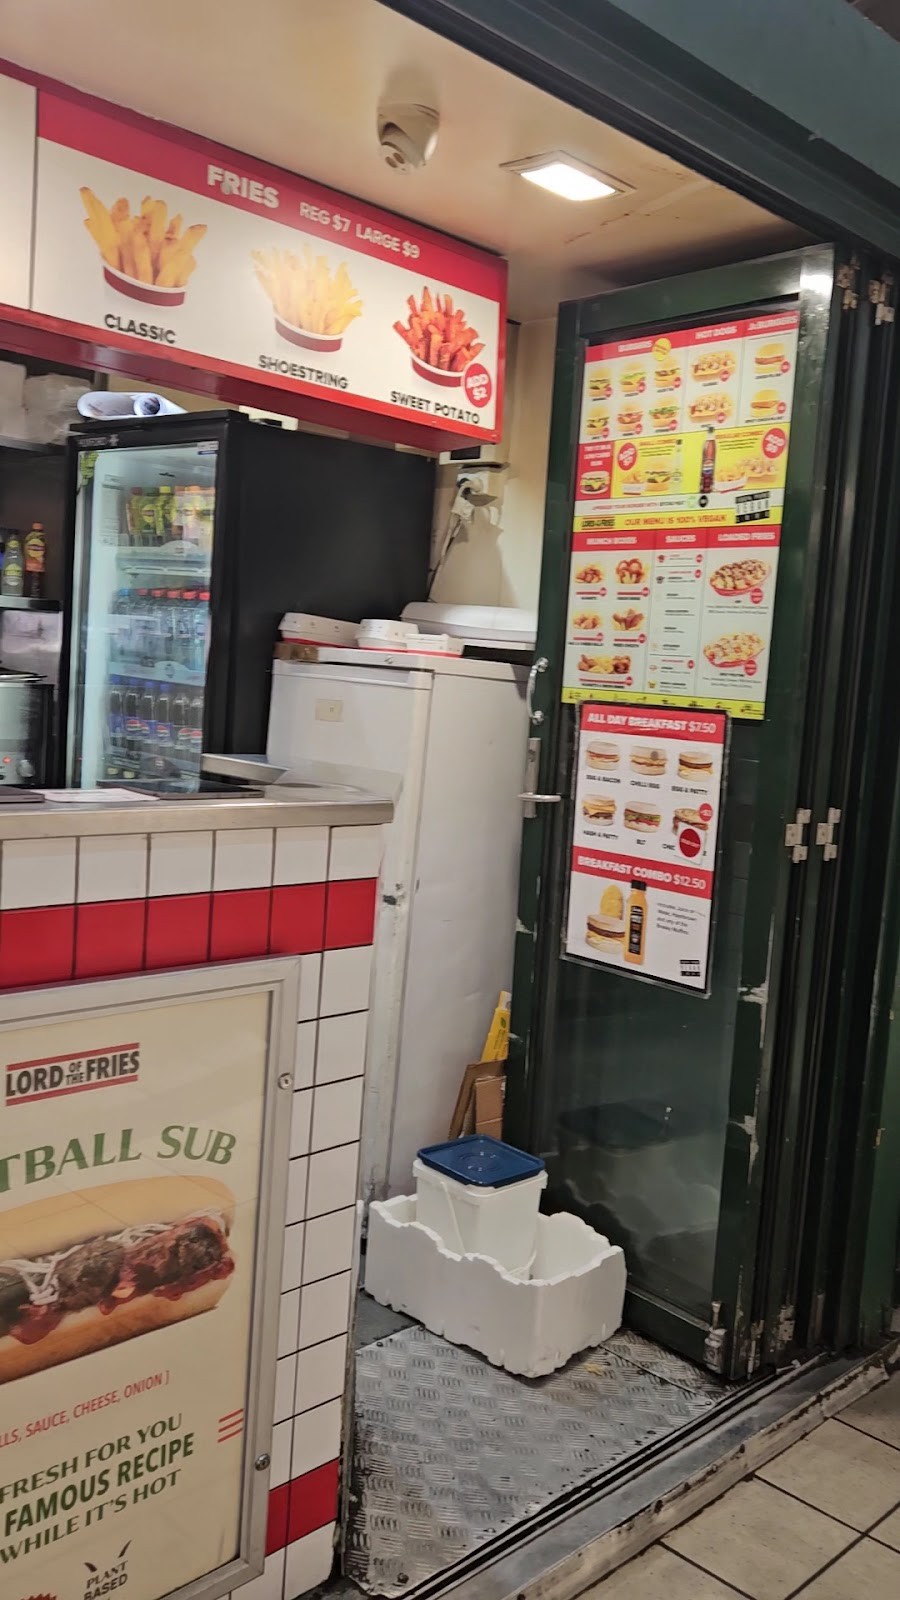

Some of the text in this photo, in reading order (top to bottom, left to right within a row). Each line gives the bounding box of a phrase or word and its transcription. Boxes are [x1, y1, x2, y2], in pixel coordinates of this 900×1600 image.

[206, 164, 280, 209] FRIES
[299, 202, 420, 259] REG $7 LARGE $9
[104, 314, 176, 344] CLASSIC
[258, 355, 349, 390] SHOESTRING
[390, 391, 480, 426] SWEET POTATO
[643, 517, 664, 525] MENU
[699, 514, 728, 522] VEGAN
[588, 713, 605, 724] ALL
[607, 715, 627, 726] DAY
[628, 716, 688, 731] BREAKFAST
[578, 856, 706, 890] BREAKFAST COMBO $12.50
[5, 1051, 140, 1098] LORD OF THE FRIES
[0, 1125, 237, 1194] TBALL SUB
[25, 1411, 70, 1437] SAUCE,
[73, 1391, 121, 1418] CHEESE,
[124, 1374, 163, 1399] ONION
[0, 1413, 182, 1505] FRESH FOR YOU
[5, 1432, 195, 1538] FAMOUS RECIPE
[0, 1469, 182, 1565] WHILE IT'S HOT
[83, 1573, 128, 1600] BASED
[86, 1560, 128, 1589] PLANT
